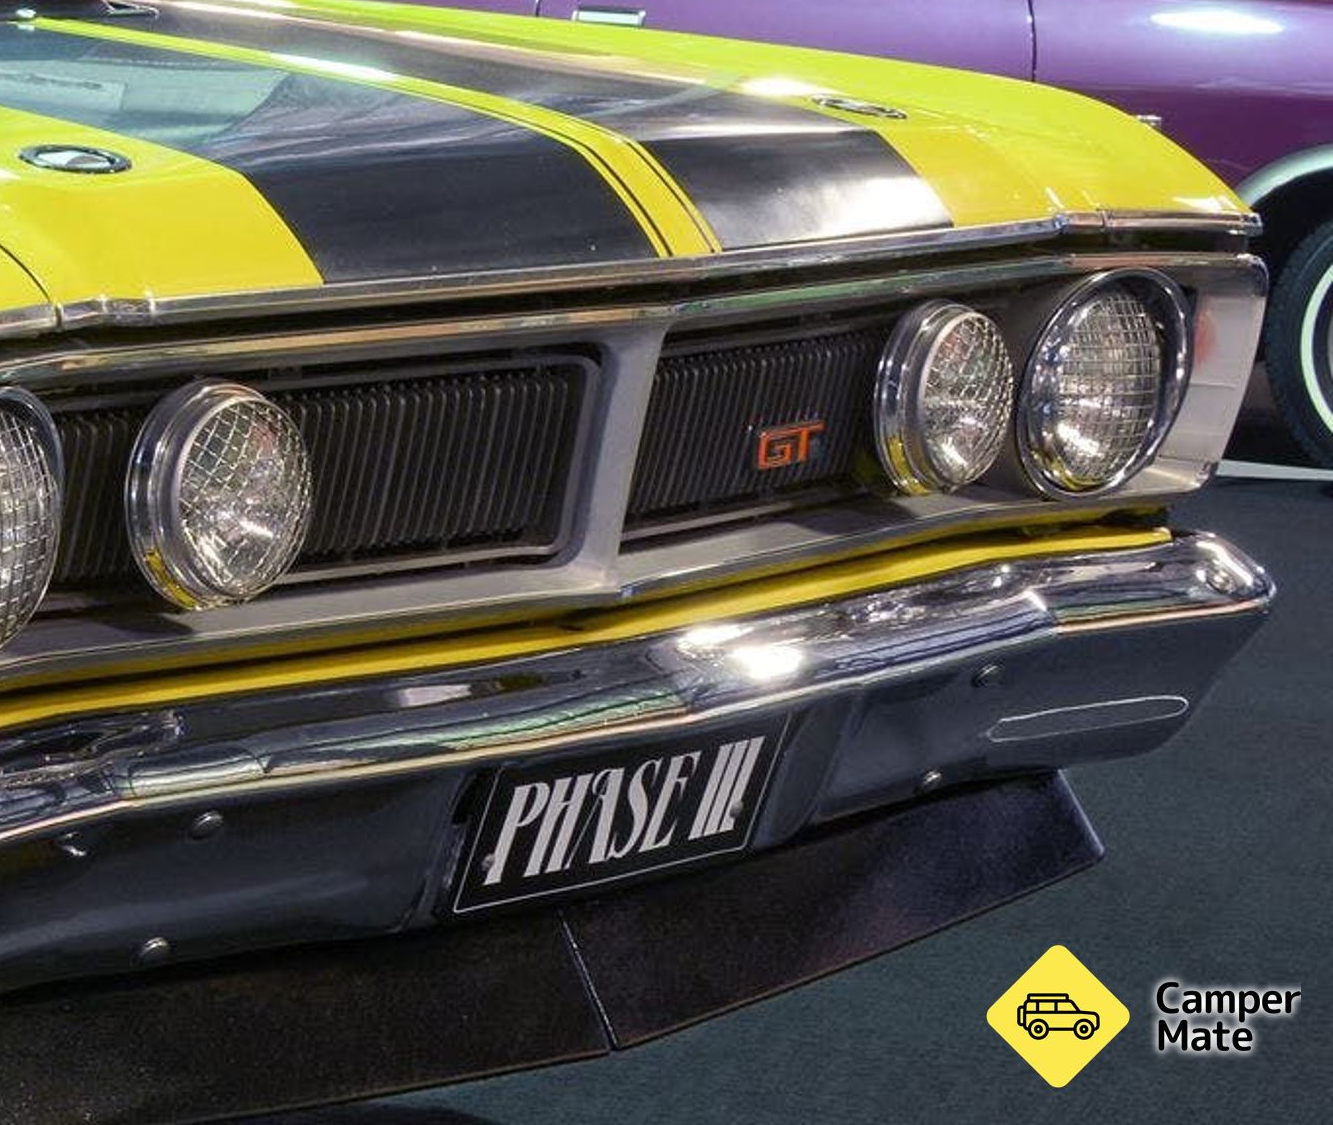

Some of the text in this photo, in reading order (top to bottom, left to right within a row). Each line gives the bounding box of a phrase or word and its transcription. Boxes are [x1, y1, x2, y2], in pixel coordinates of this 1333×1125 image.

[757, 420, 827, 470] GT
[482, 735, 766, 886] PHASE III
